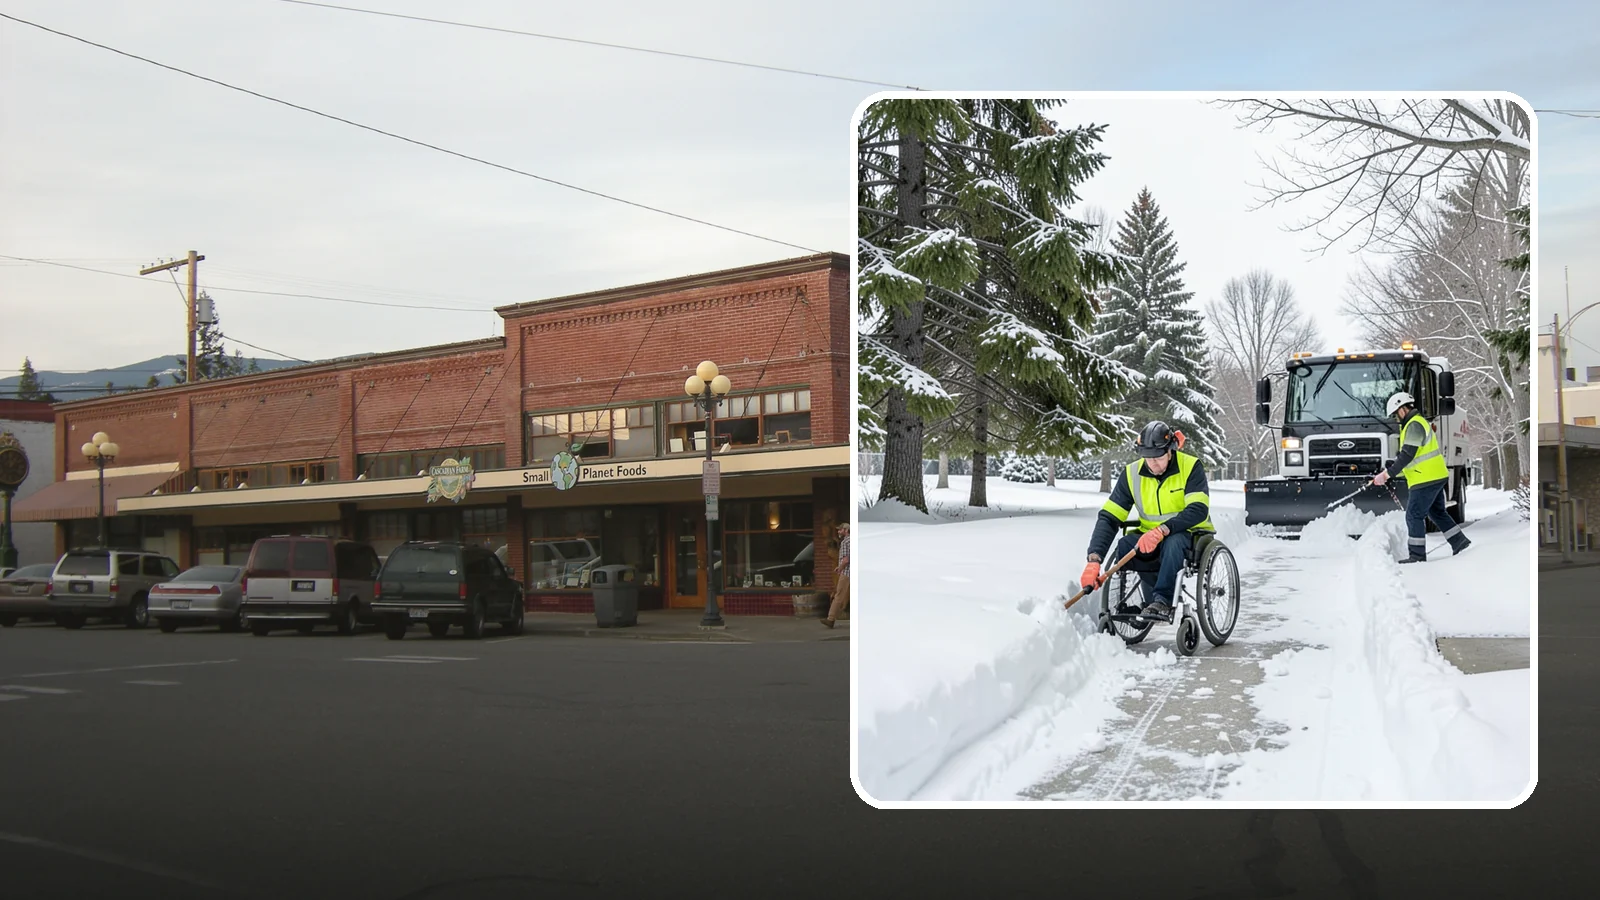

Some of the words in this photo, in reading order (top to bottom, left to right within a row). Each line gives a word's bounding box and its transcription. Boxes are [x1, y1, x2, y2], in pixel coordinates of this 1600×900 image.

[431, 466, 456, 476] CASCADIAN
[523, 471, 548, 482] Small
[583, 467, 613, 479] Planet
[617, 464, 647, 476] Foods
